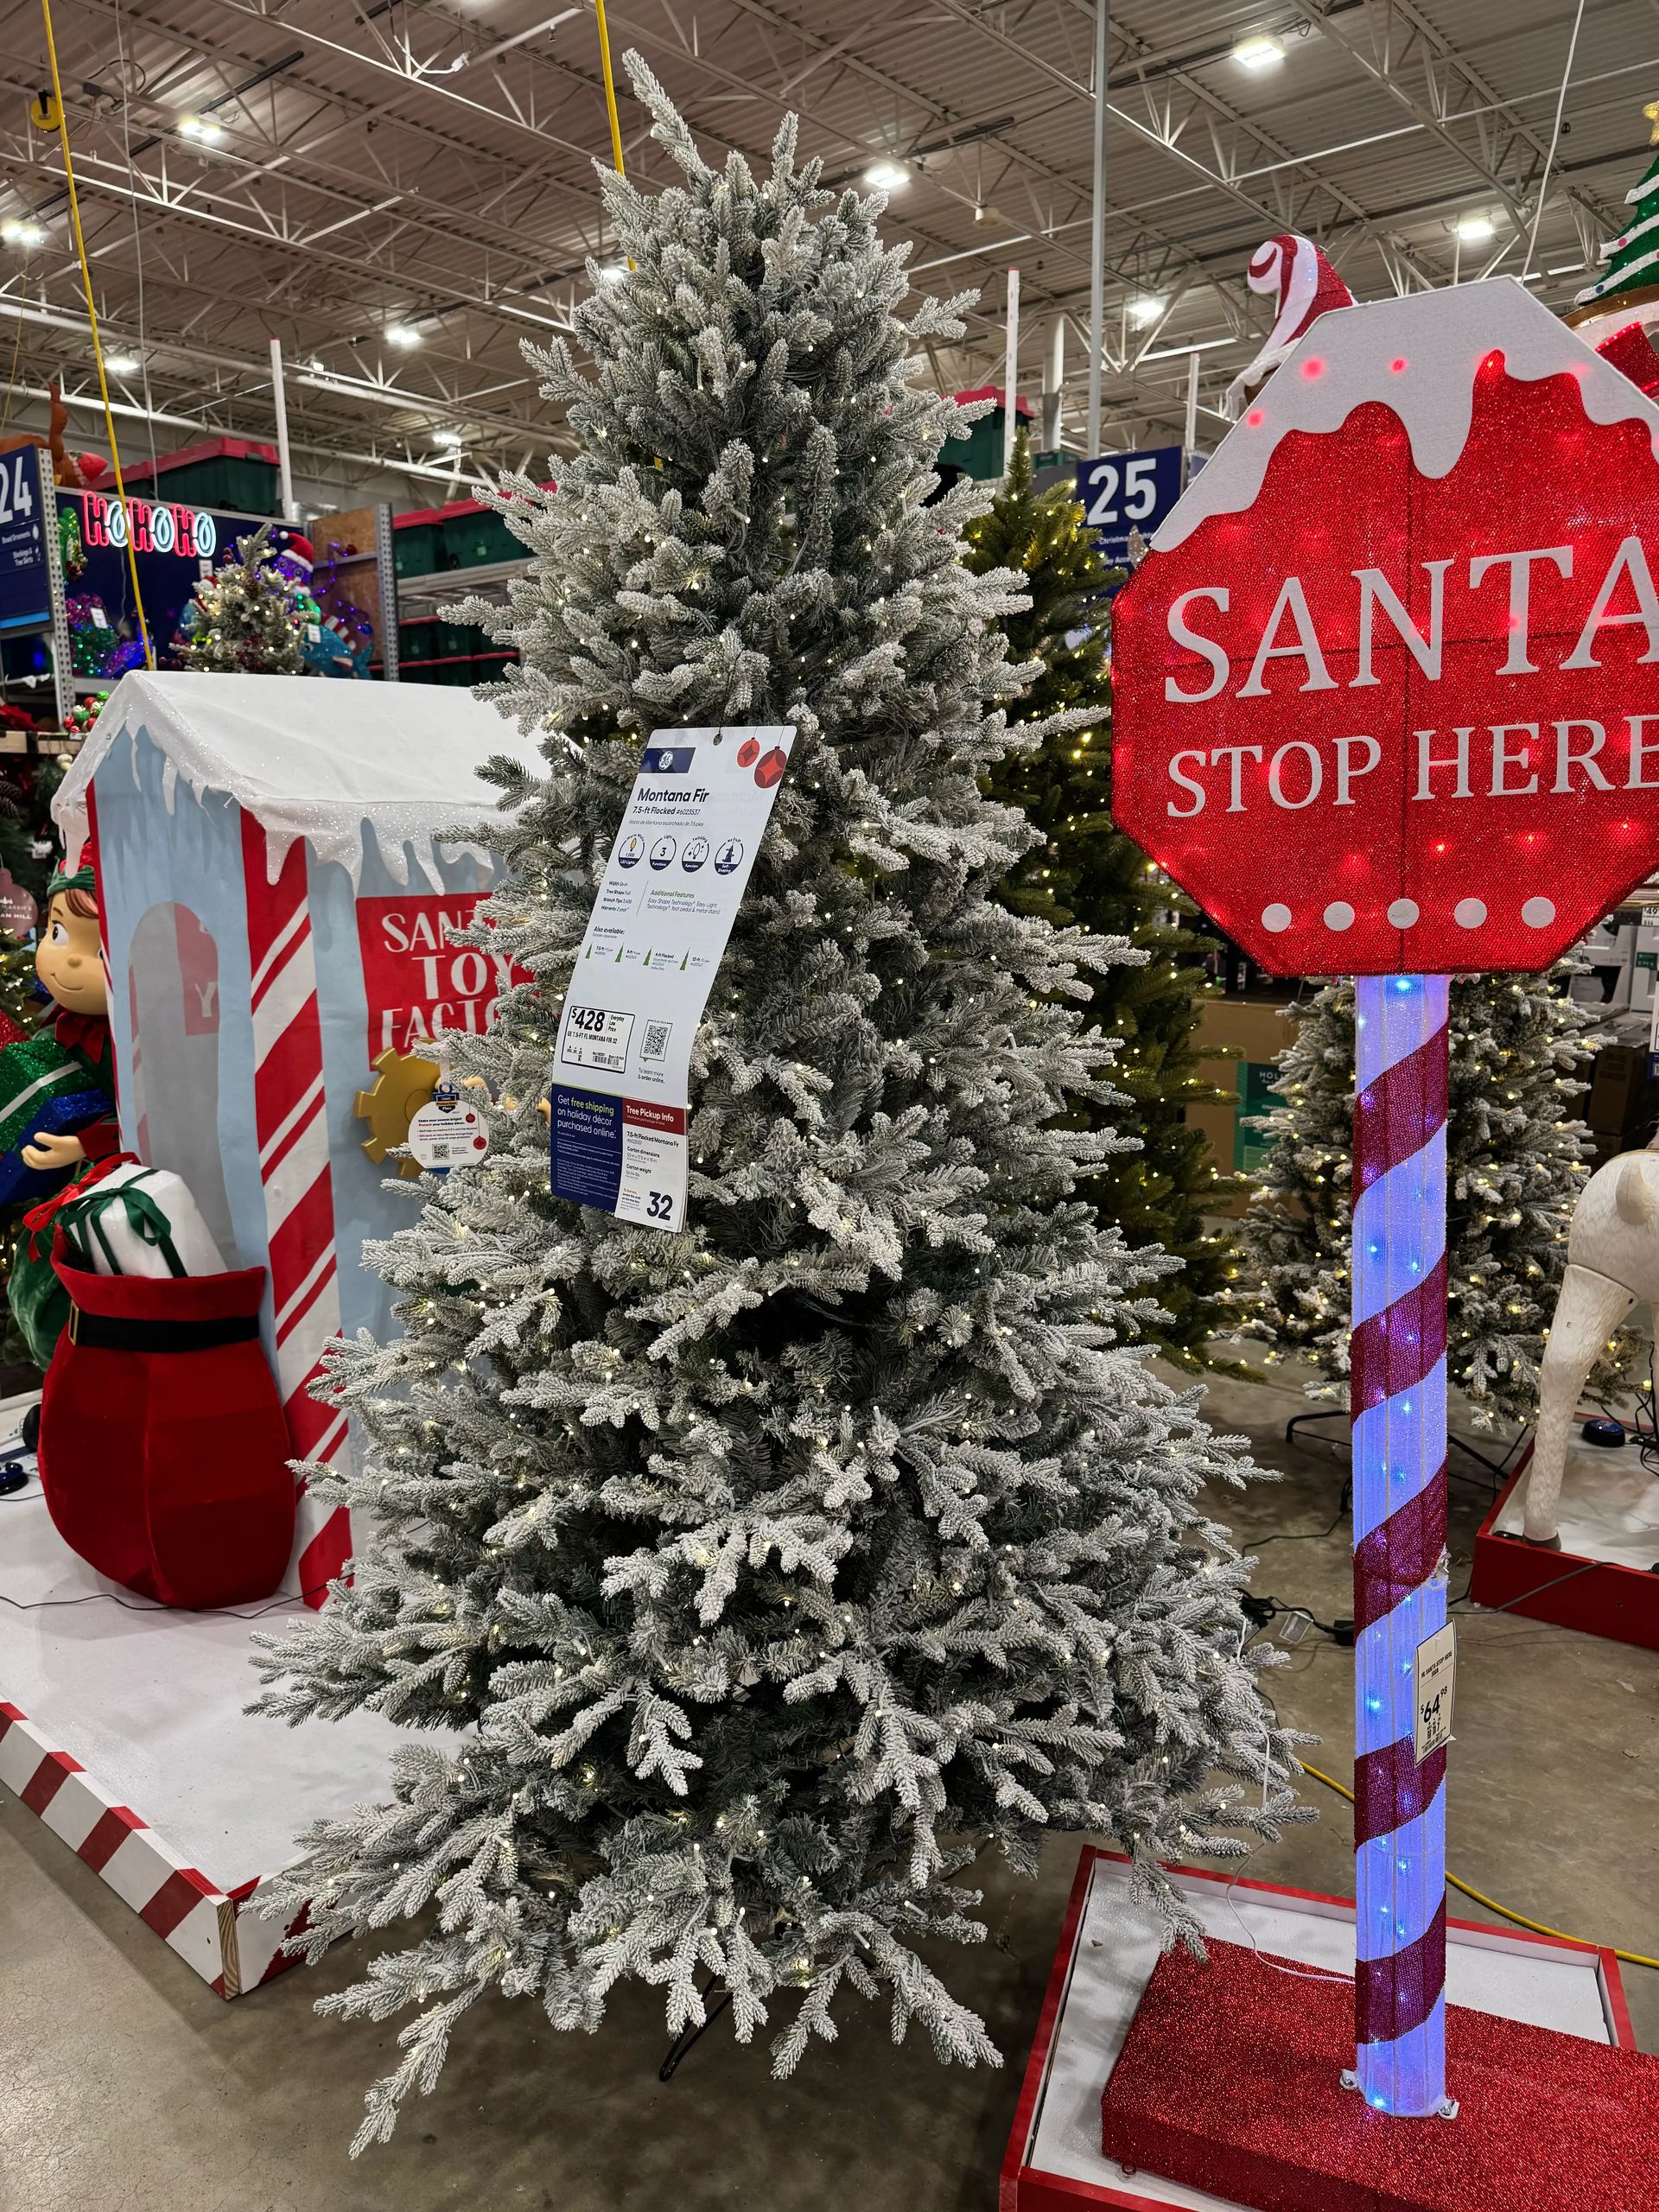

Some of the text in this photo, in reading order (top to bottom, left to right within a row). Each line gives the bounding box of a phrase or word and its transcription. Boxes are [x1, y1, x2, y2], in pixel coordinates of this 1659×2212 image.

[0, 456, 33, 524] 24
[1087, 458, 1156, 525] 25
[1165, 536, 1659, 703] SANTA
[1167, 715, 1659, 818] STOP HERE
[637, 788, 710, 803] Montana Fir
[651, 807, 676, 815] Flocked
[660, 847, 667, 856] 3
[411, 952, 516, 1001] TOY
[571, 1008, 605, 1032] $428
[610, 1014, 624, 1022] Everyday
[589, 1034, 605, 1042] MONTANA
[558, 1095, 614, 1116] Get free shipping
[626, 1105, 639, 1115] Tree
[640, 1108, 660, 1120] Pickup
[662, 1113, 674, 1122] Info
[567, 1108, 591, 1123] holiday
[592, 1113, 612, 1126] décor
[557, 1120, 592, 1134] purchased
[639, 1132, 653, 1142] Flocked
[654, 1137, 673, 1146] Montana
[641, 1149, 660, 1158] dimensions
[647, 1191, 673, 1221] 32
[1426, 1663, 1435, 1673] SANTA
[1436, 1656, 1444, 1667] STOP
